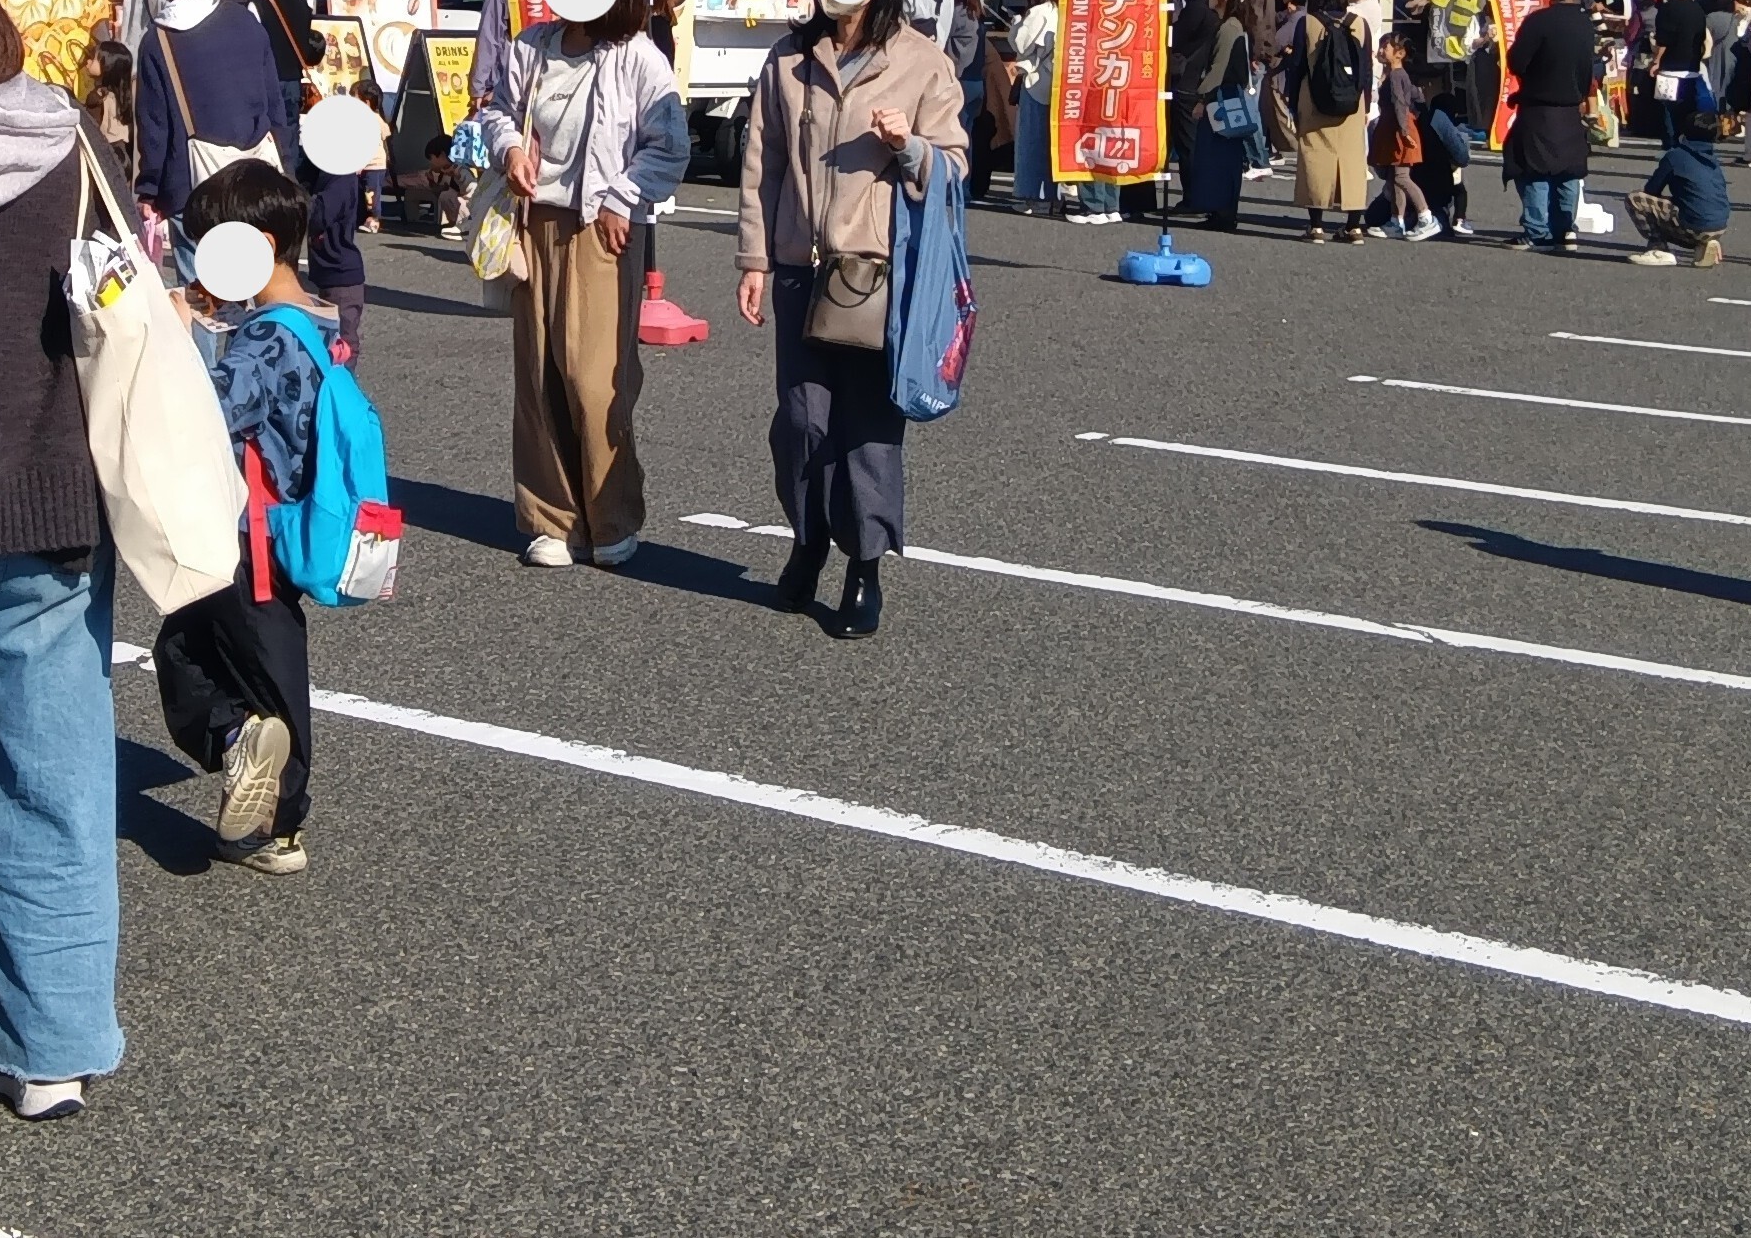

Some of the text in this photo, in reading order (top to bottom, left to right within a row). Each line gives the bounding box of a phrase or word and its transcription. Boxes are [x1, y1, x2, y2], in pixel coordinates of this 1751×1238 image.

[435, 46, 469, 57] DRINKS
[1067, 22, 1087, 83] KITCHEN
[1064, 90, 1081, 119] CAR
